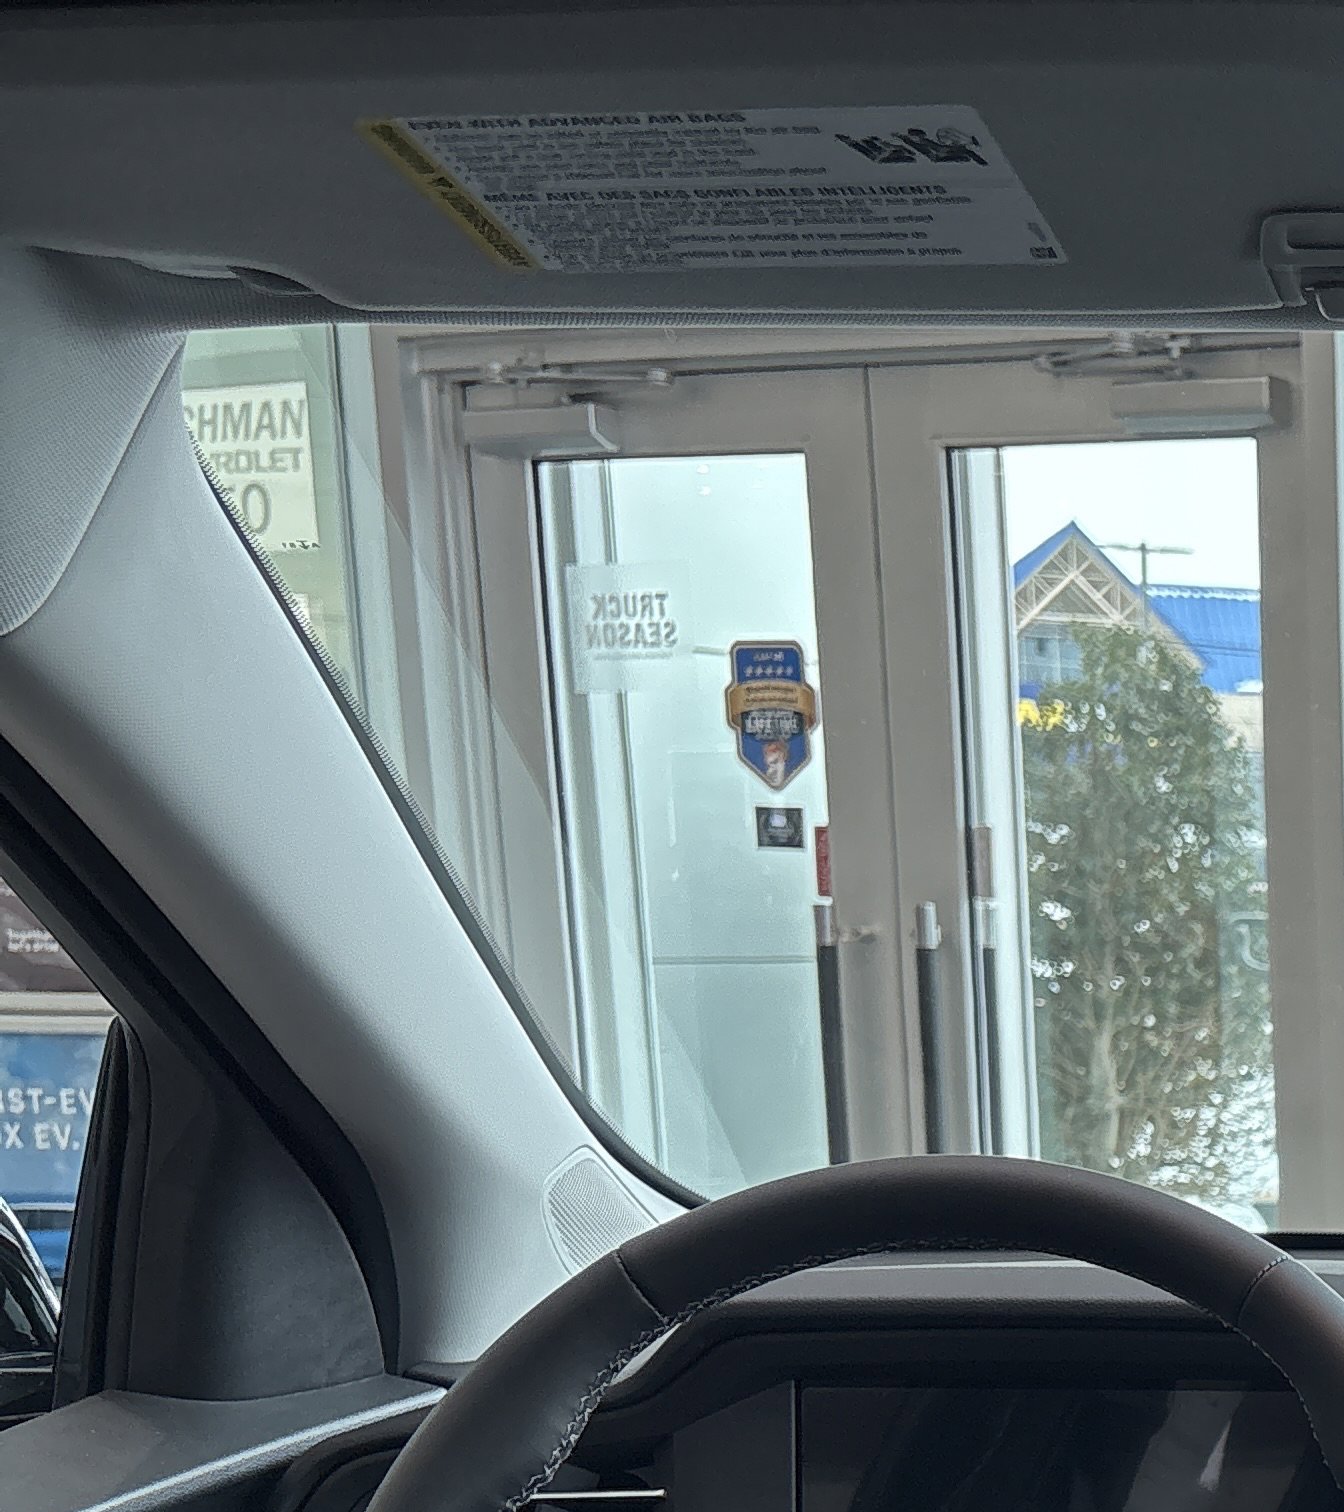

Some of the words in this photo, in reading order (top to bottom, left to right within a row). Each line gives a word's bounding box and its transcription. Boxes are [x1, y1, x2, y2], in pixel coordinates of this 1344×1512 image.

[183, 399, 305, 443] HMAN
[209, 447, 304, 474] ROLET
[0, 1120, 24, 1149] X
[34, 1120, 80, 1151] EV.
